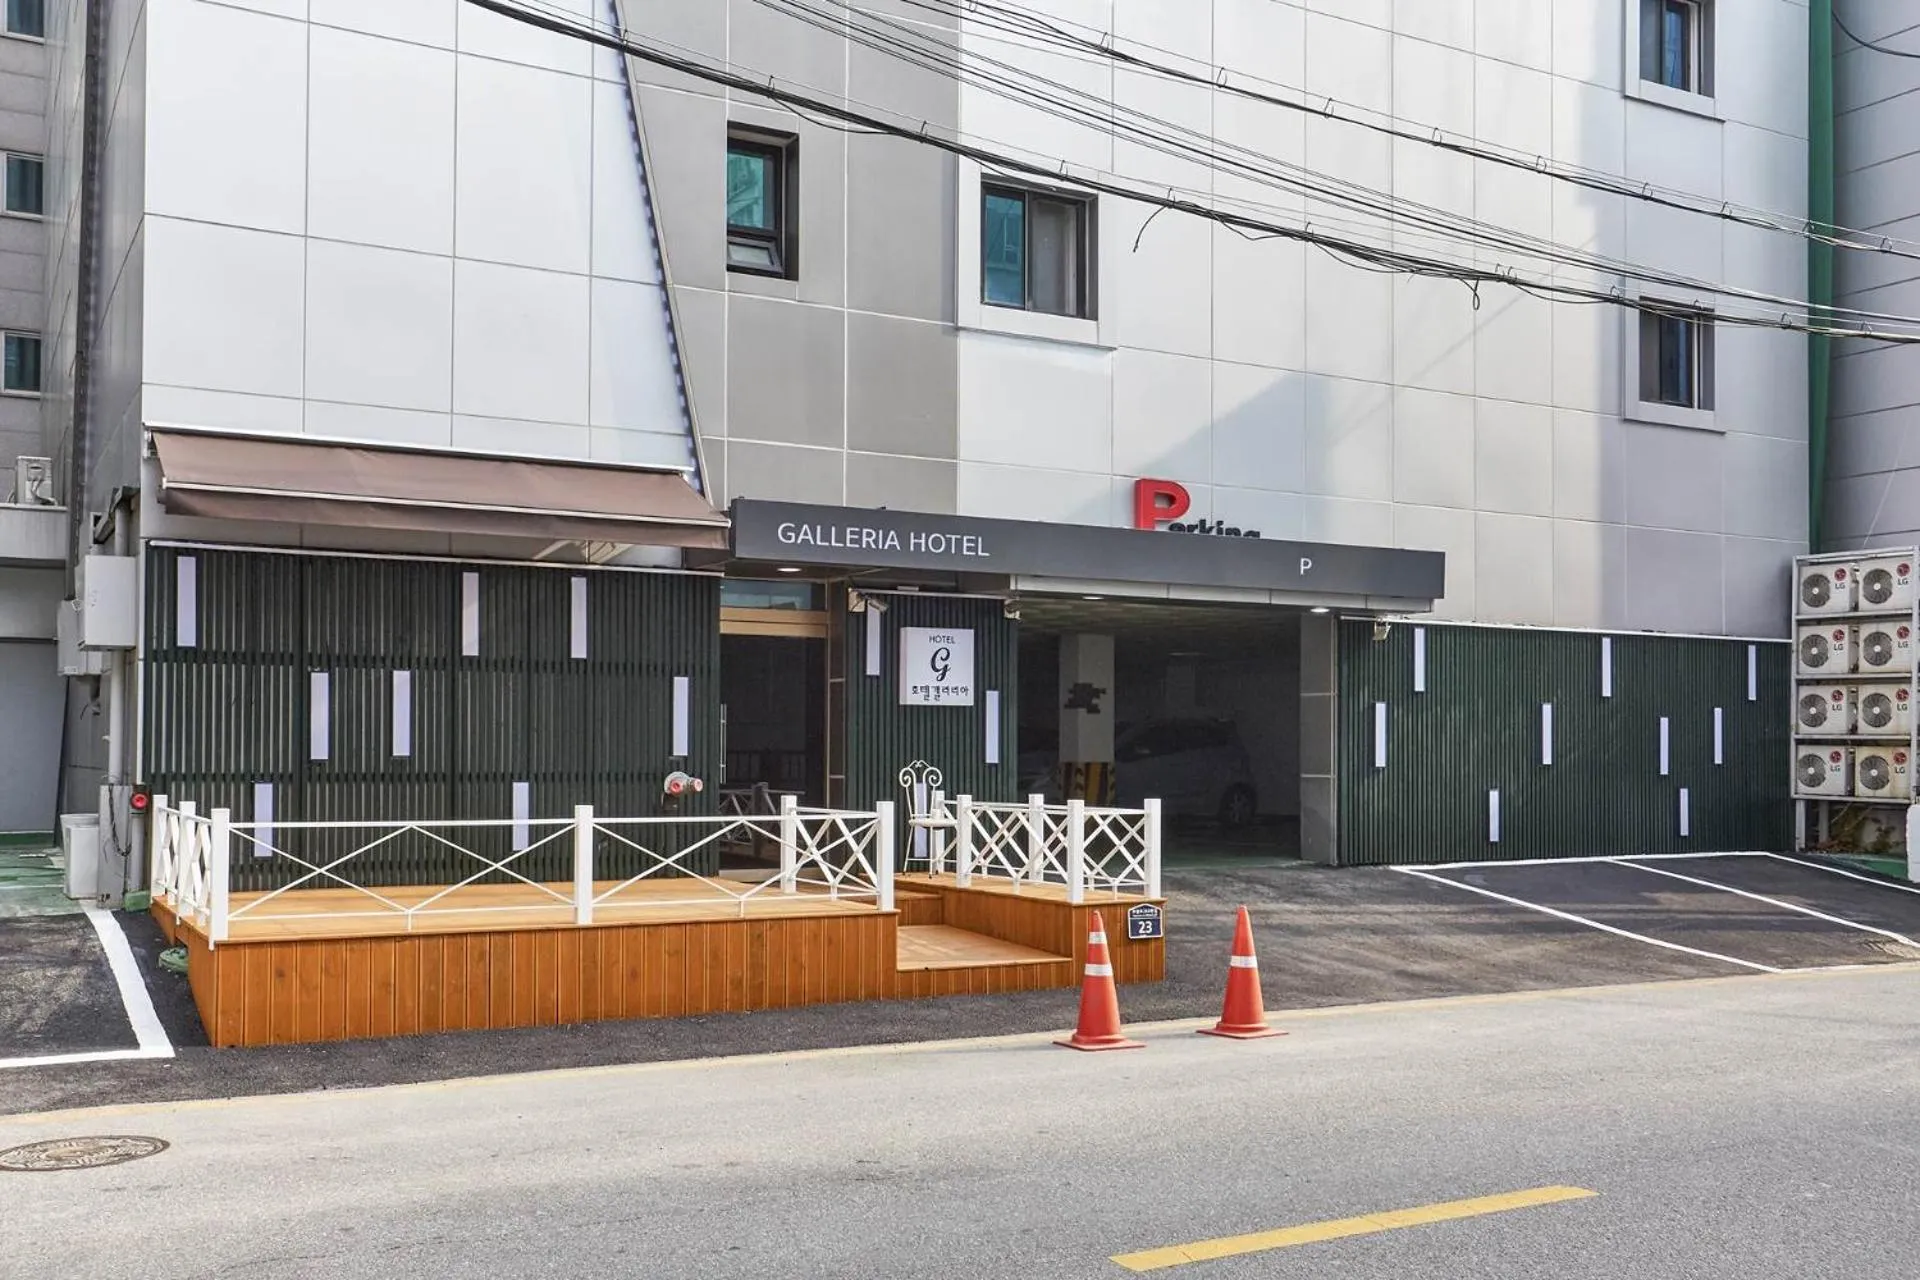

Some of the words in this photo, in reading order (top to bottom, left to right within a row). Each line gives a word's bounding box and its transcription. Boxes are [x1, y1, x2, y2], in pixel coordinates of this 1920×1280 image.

[777, 522, 901, 550] GALLERIA
[909, 531, 990, 556] HOTEL
[1299, 557, 1313, 575] P
[1834, 582, 1846, 590] LG
[1897, 578, 1909, 586] LG
[929, 635, 956, 645] HOTEL
[1833, 643, 1844, 651] LG
[1897, 641, 1909, 649] LG
[1832, 704, 1843, 712] LG
[1897, 703, 1909, 711] LG
[1830, 765, 1841, 773] LG
[1894, 766, 1906, 774] LG
[1138, 920, 1153, 934] 23
